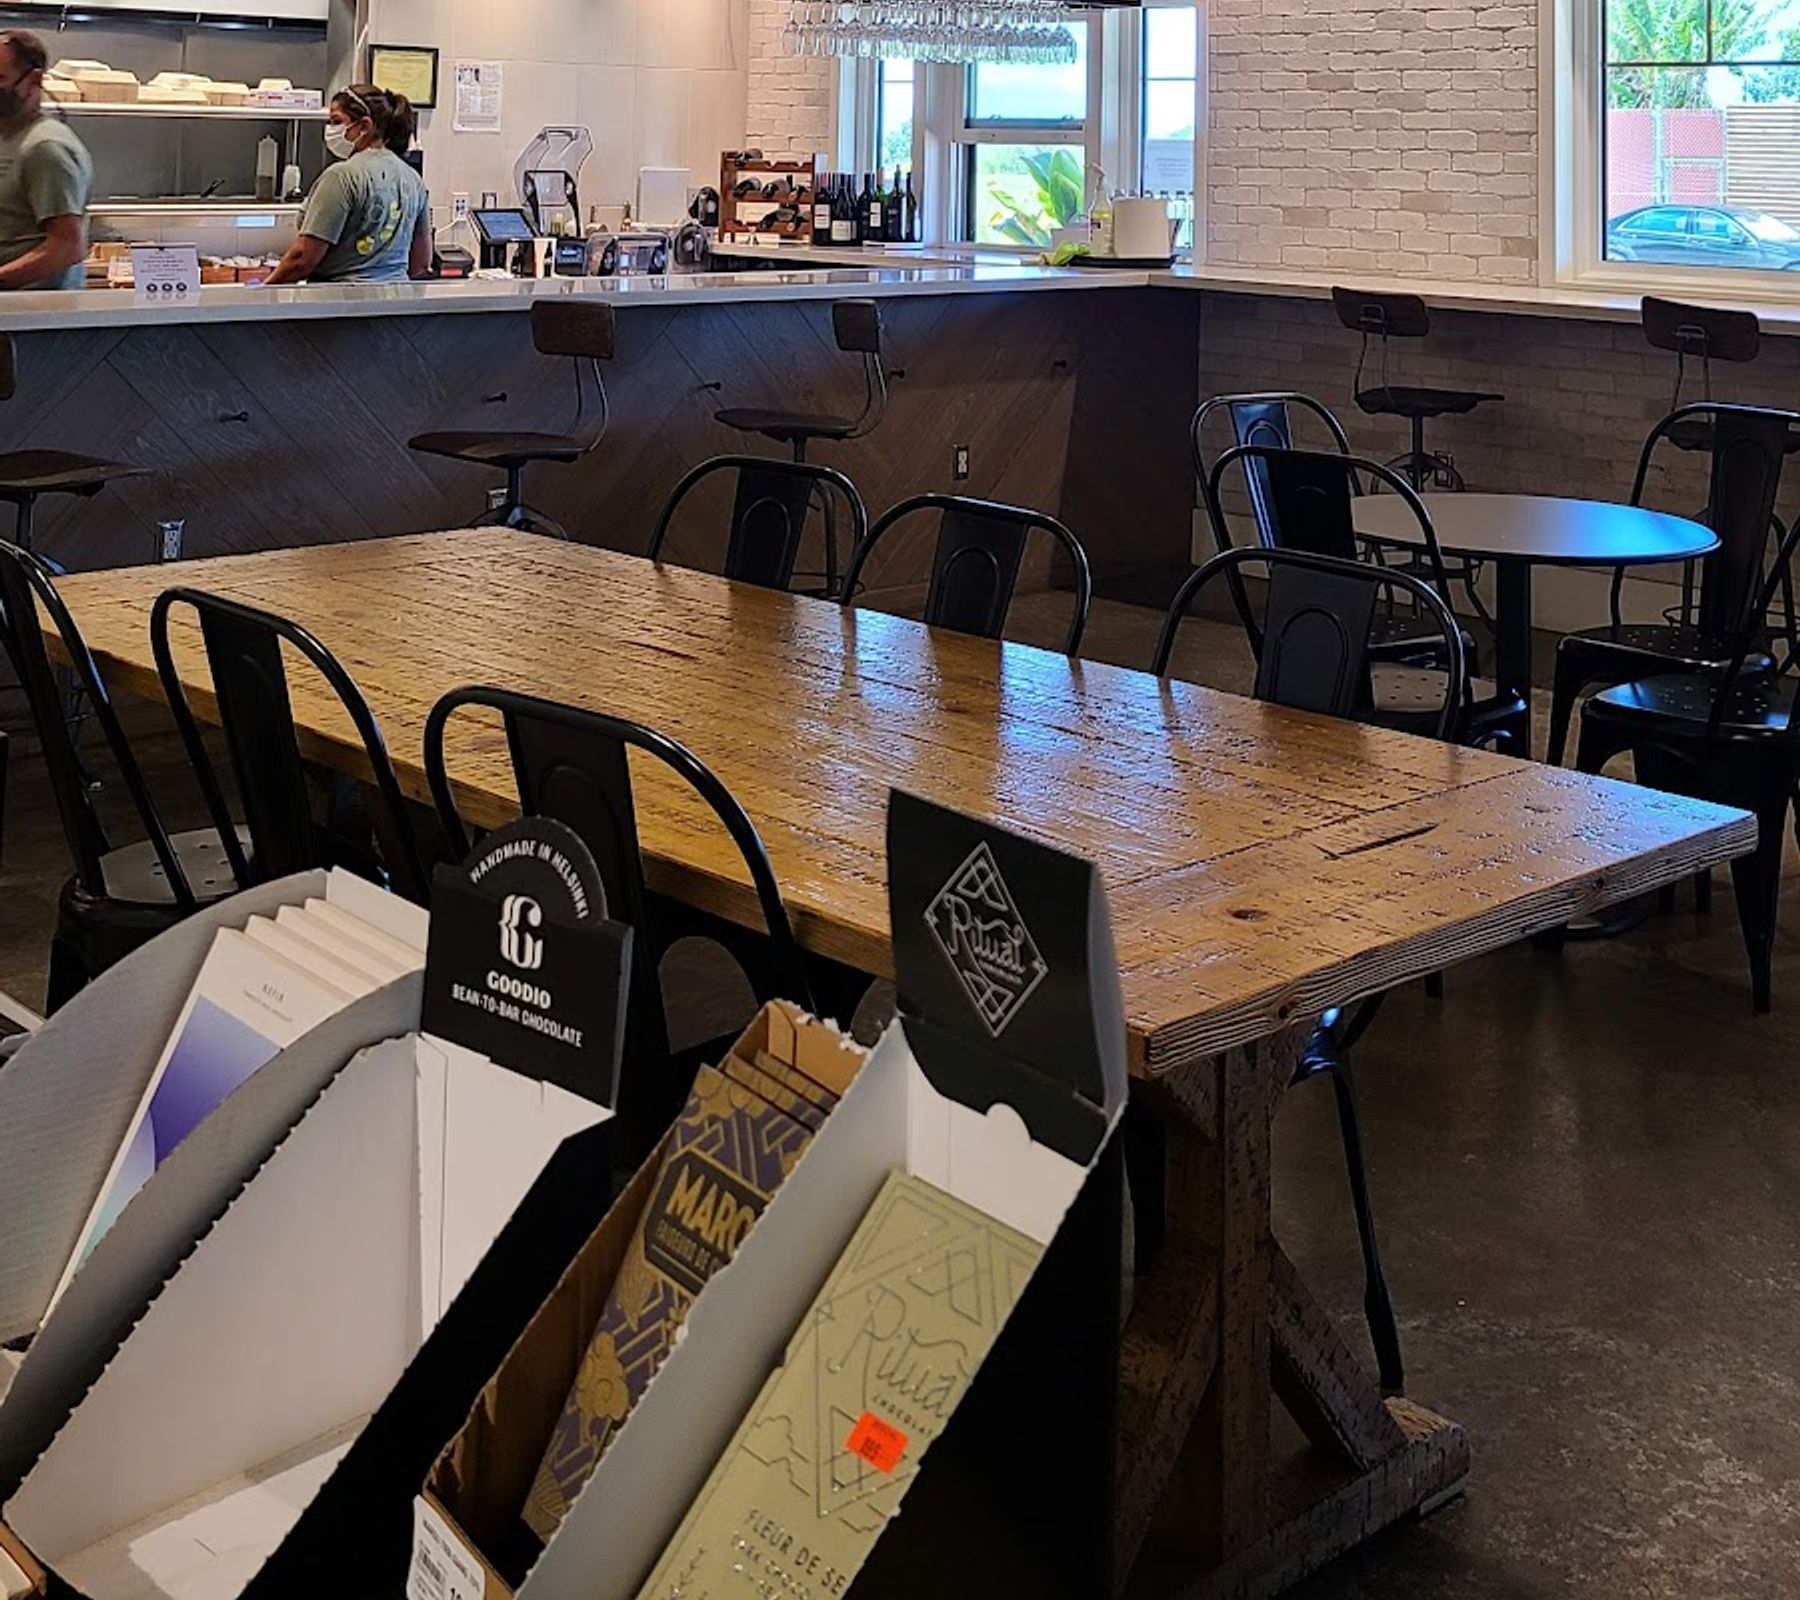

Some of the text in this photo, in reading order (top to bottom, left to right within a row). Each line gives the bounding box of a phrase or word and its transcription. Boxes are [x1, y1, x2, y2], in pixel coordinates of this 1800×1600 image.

[469, 839, 590, 920] HANDMADE IN HELSINKI
[452, 983, 583, 1048] BEAN-TO-BAR CHOCOLATE
[486, 970, 551, 1010] GOODIO
[665, 1163, 755, 1258] MARO
[827, 1281, 970, 1419] Ritua
[872, 1393, 934, 1438] CHOCOLAT
[744, 1508, 794, 1556] FLEUR
[794, 1546, 822, 1576] DE
[821, 1566, 848, 1596] SE
